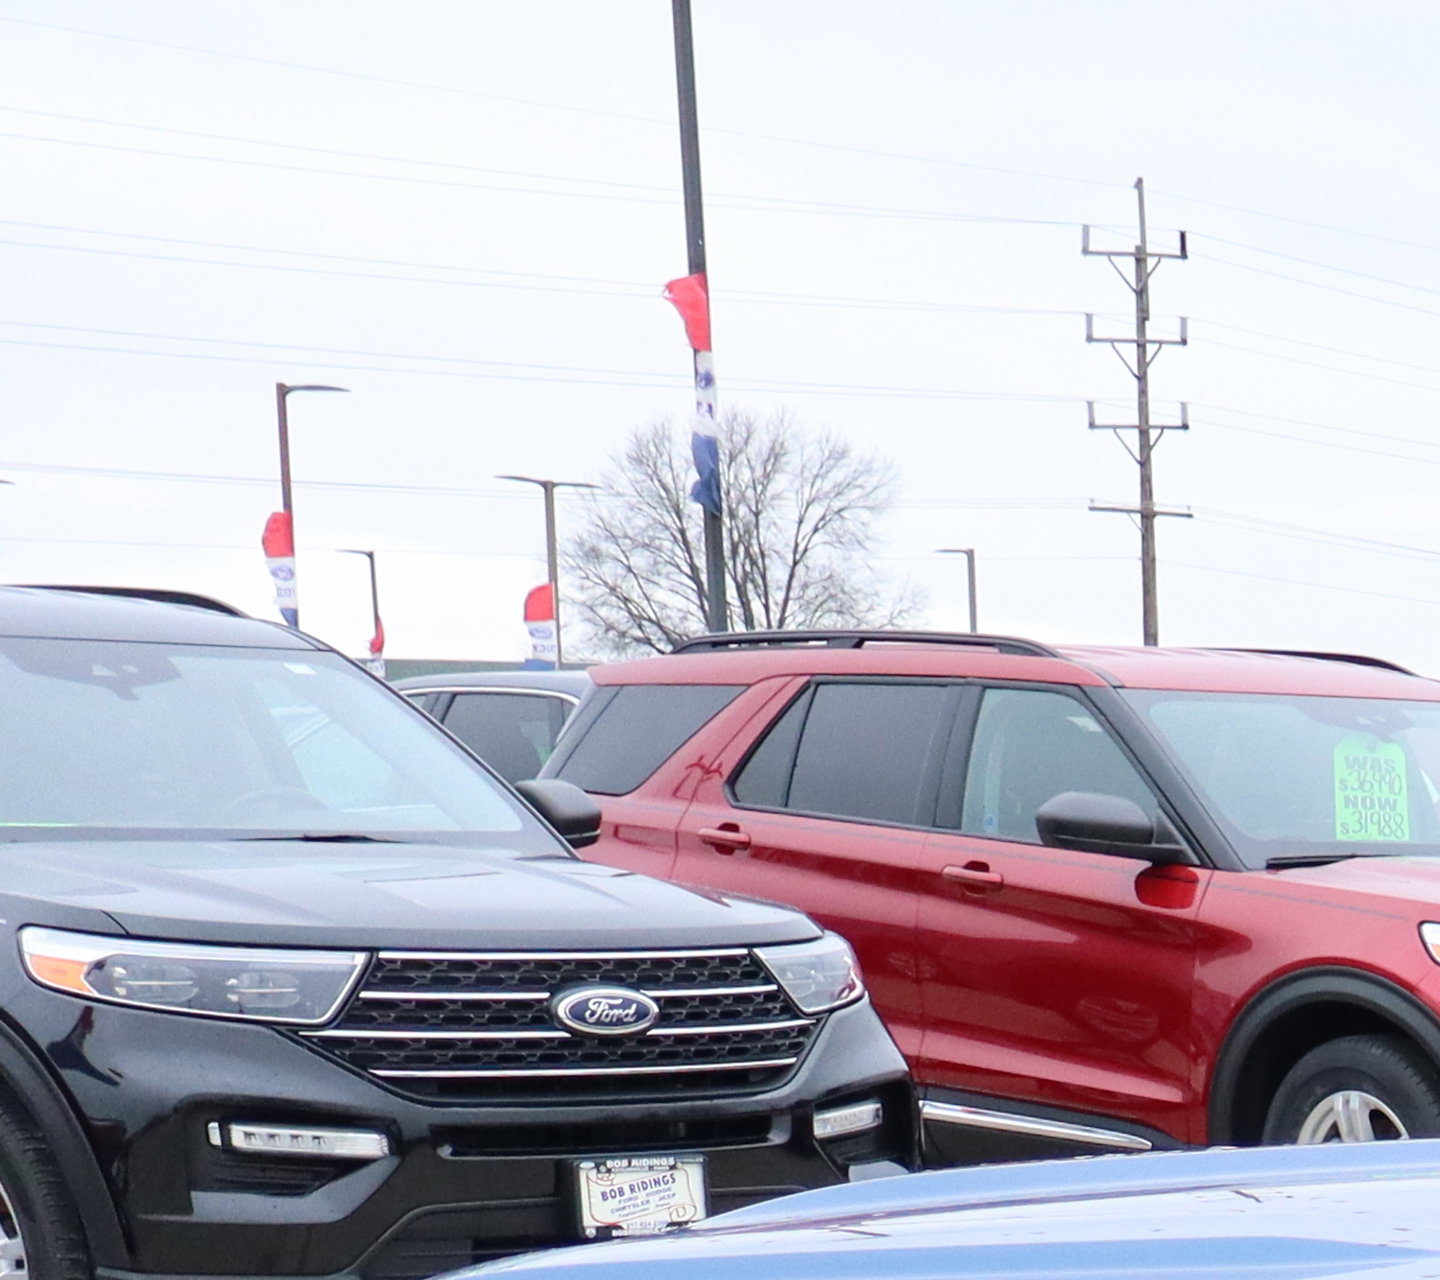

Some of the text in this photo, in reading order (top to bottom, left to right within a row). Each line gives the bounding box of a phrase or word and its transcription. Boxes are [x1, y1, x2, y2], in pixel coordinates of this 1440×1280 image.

[1344, 756, 1396, 773] WAS
[1343, 795, 1397, 811] NOW
[585, 998, 637, 1023] Ford
[606, 1157, 675, 1168] BOB RIDINGS
[601, 1173, 676, 1202] BOB RIDINGS
